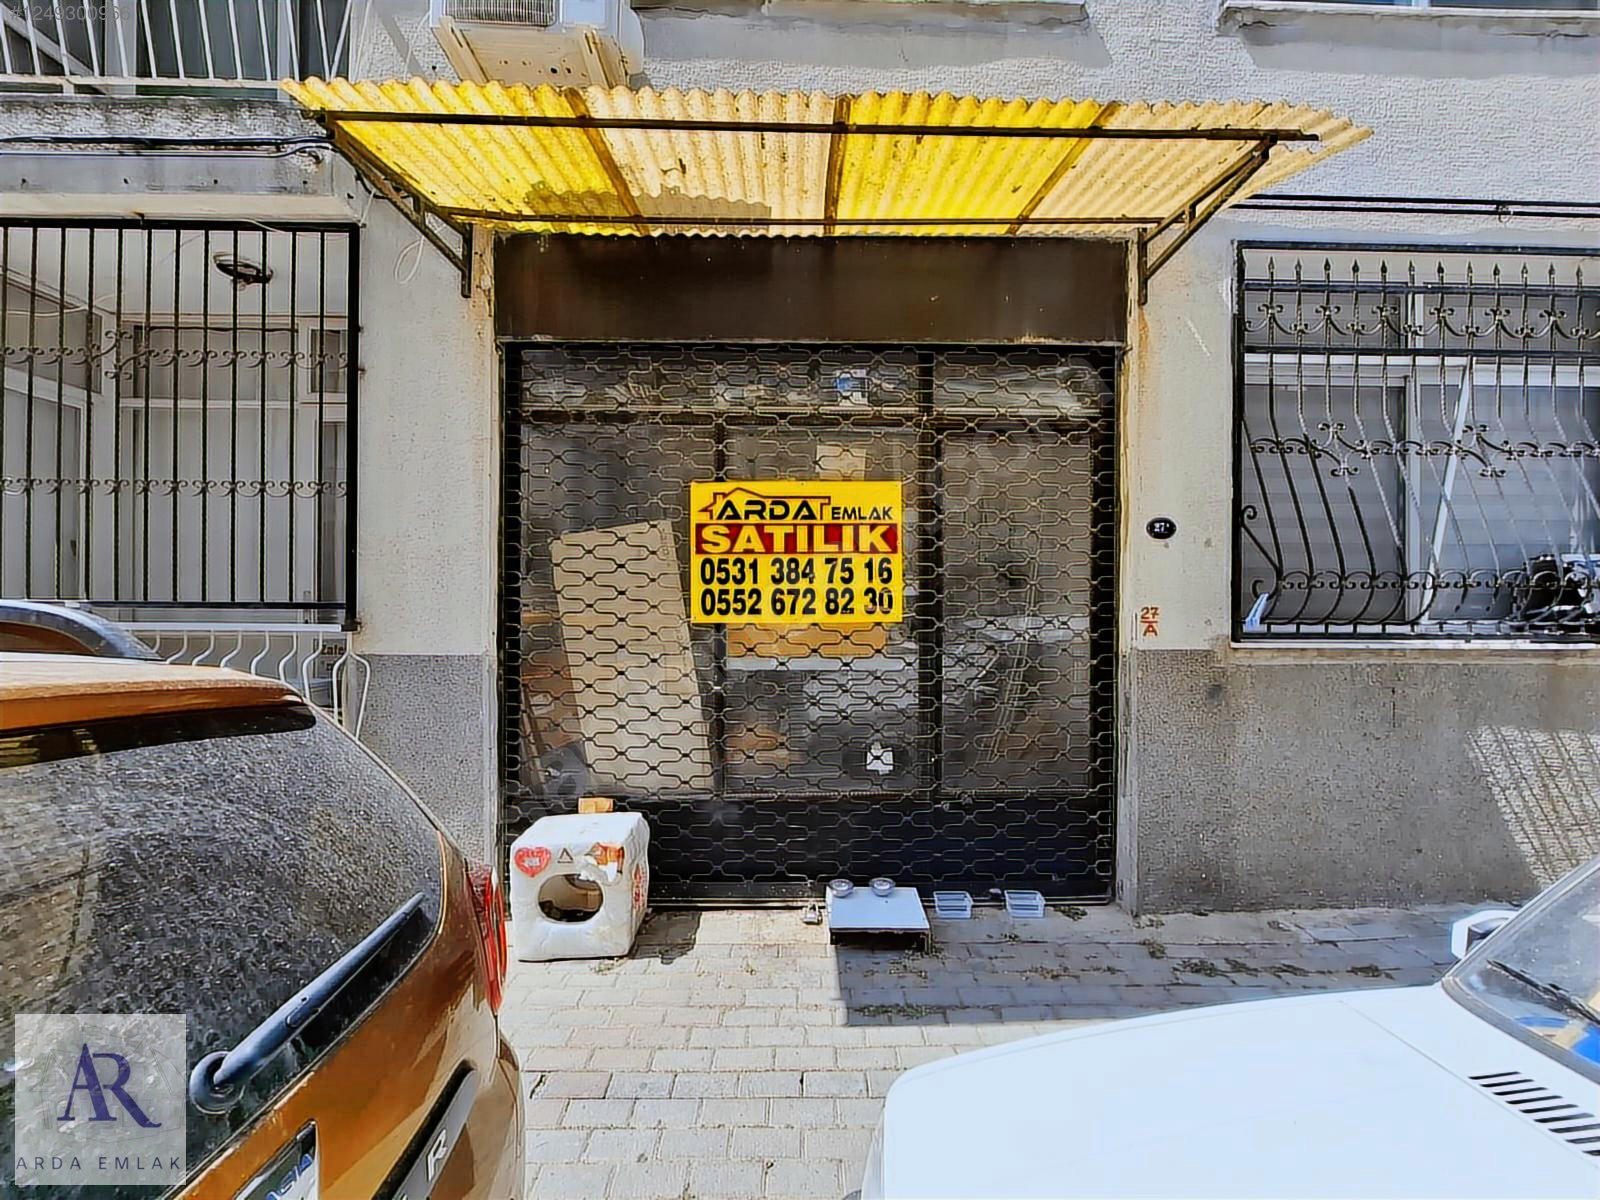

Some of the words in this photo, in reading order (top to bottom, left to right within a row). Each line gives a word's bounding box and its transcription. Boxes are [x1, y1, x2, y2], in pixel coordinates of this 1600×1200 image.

[717, 499, 817, 521] ARDA
[831, 506, 893, 521] EMLAK
[701, 524, 893, 553] SATILIK
[700, 557, 758, 585] 0531
[770, 557, 815, 585] 384
[824, 557, 854, 585] 75
[864, 557, 893, 585] 16
[700, 587, 762, 616] 0552
[771, 587, 816, 616] 672
[825, 587, 855, 616] 82
[863, 587, 894, 616] 30
[1140, 606, 1159, 620] 27
[1143, 624, 1158, 637] A
